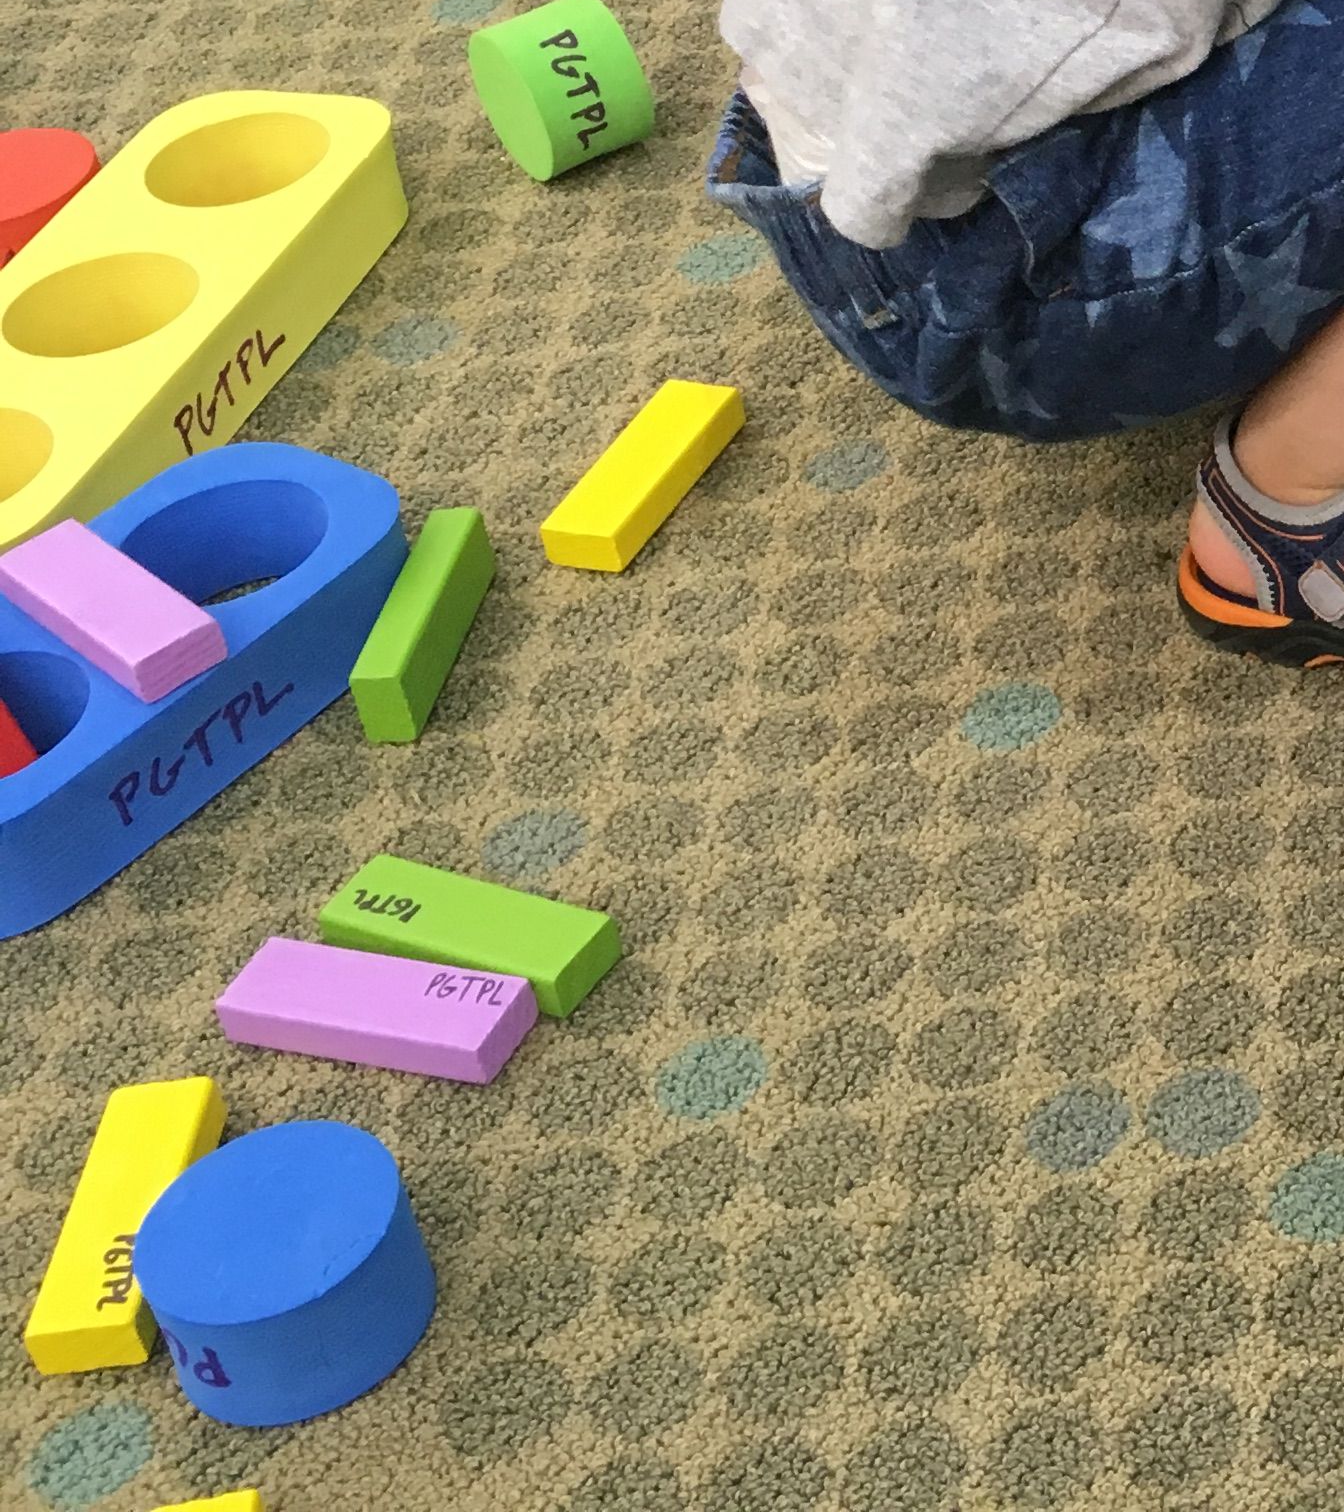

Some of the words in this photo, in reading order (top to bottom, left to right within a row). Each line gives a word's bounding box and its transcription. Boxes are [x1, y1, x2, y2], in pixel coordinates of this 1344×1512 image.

[539, 29, 608, 151] PGTPL
[173, 329, 286, 457] PGTPL
[108, 680, 295, 826] PGTPL
[424, 972, 505, 1006] PGTPL
